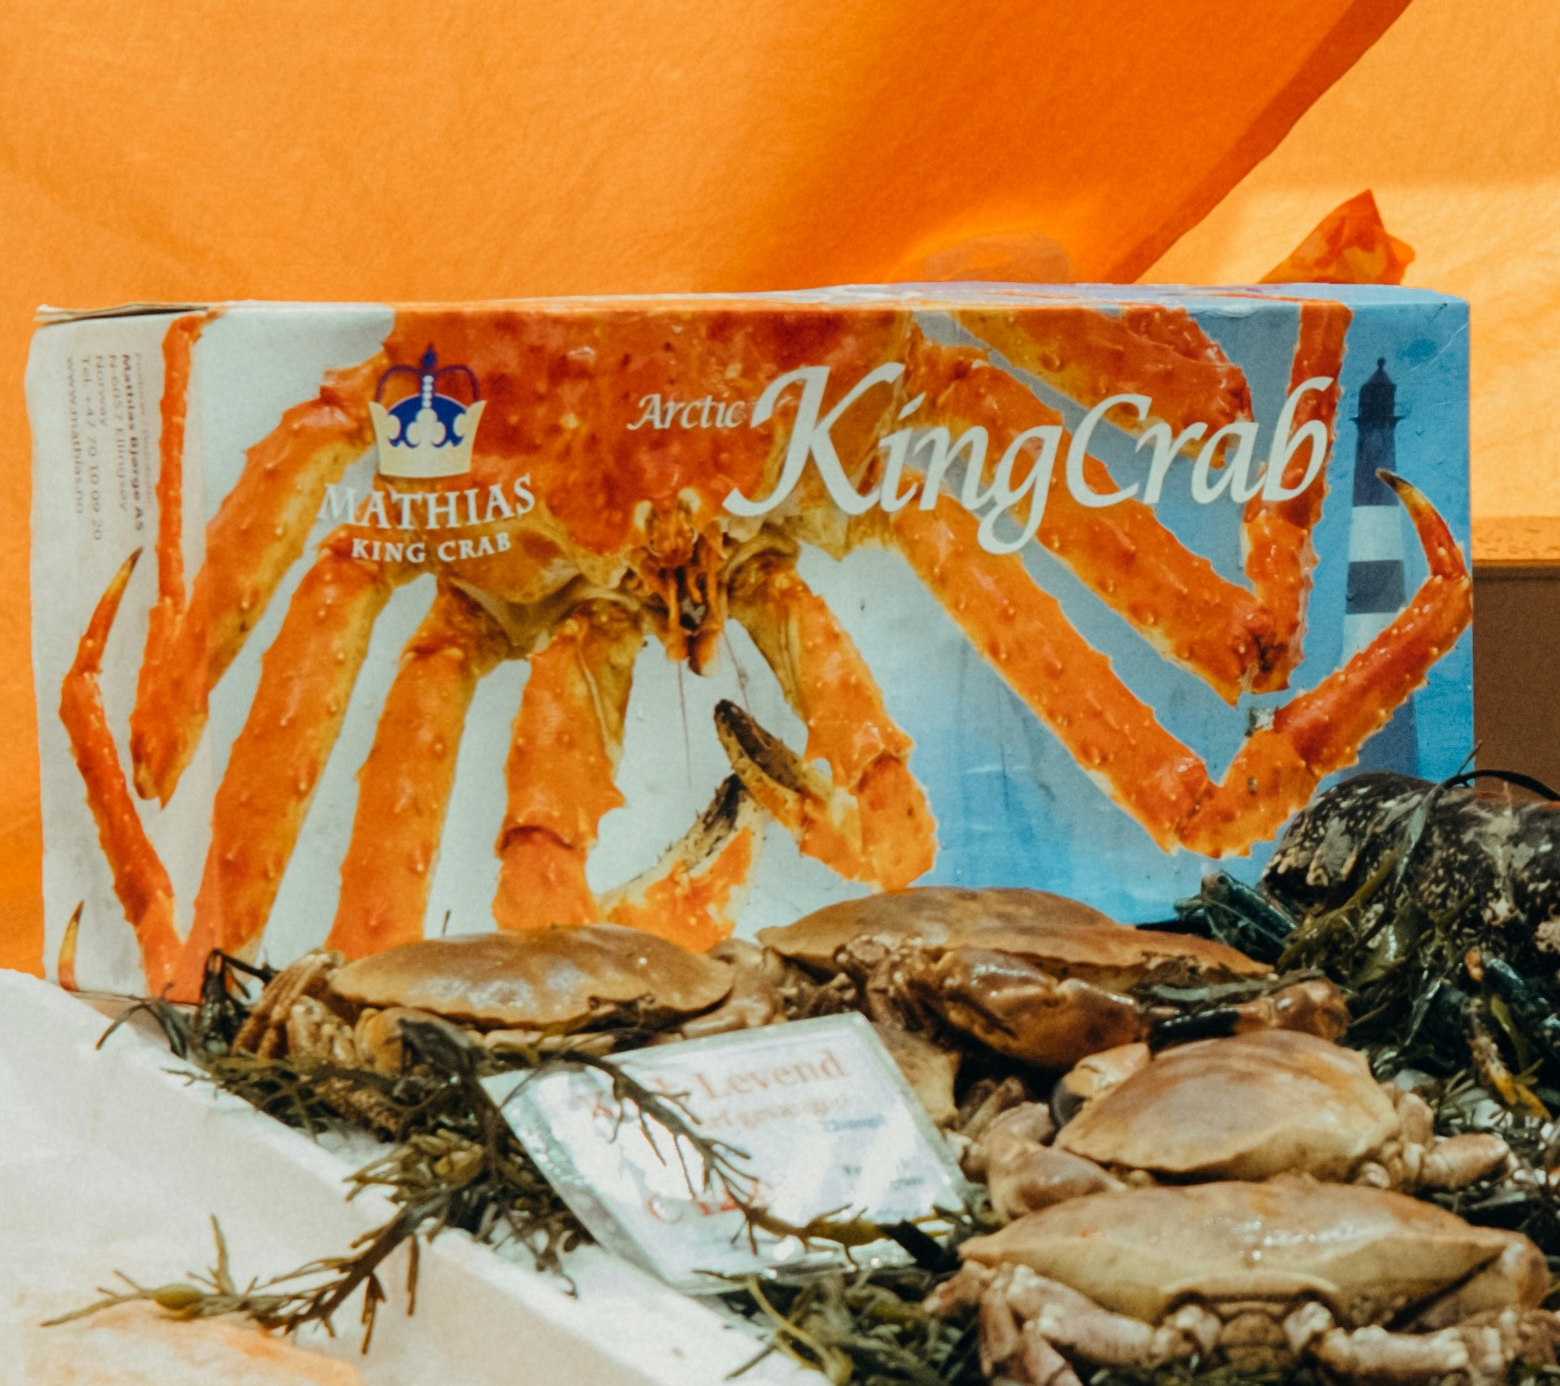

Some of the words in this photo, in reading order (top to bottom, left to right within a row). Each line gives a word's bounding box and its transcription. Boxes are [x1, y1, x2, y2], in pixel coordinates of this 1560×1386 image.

[95, 355, 109, 427] Norway
[626, 393, 746, 431] Arctic
[66, 356, 85, 515] www.mathias.no
[122, 354, 136, 431] Mathias
[134, 506, 145, 532] AS
[317, 473, 536, 530] MATHIAS
[351, 538, 427, 563] KING
[437, 531, 512, 562] CRAB
[695, 1048, 849, 1099] Levend
